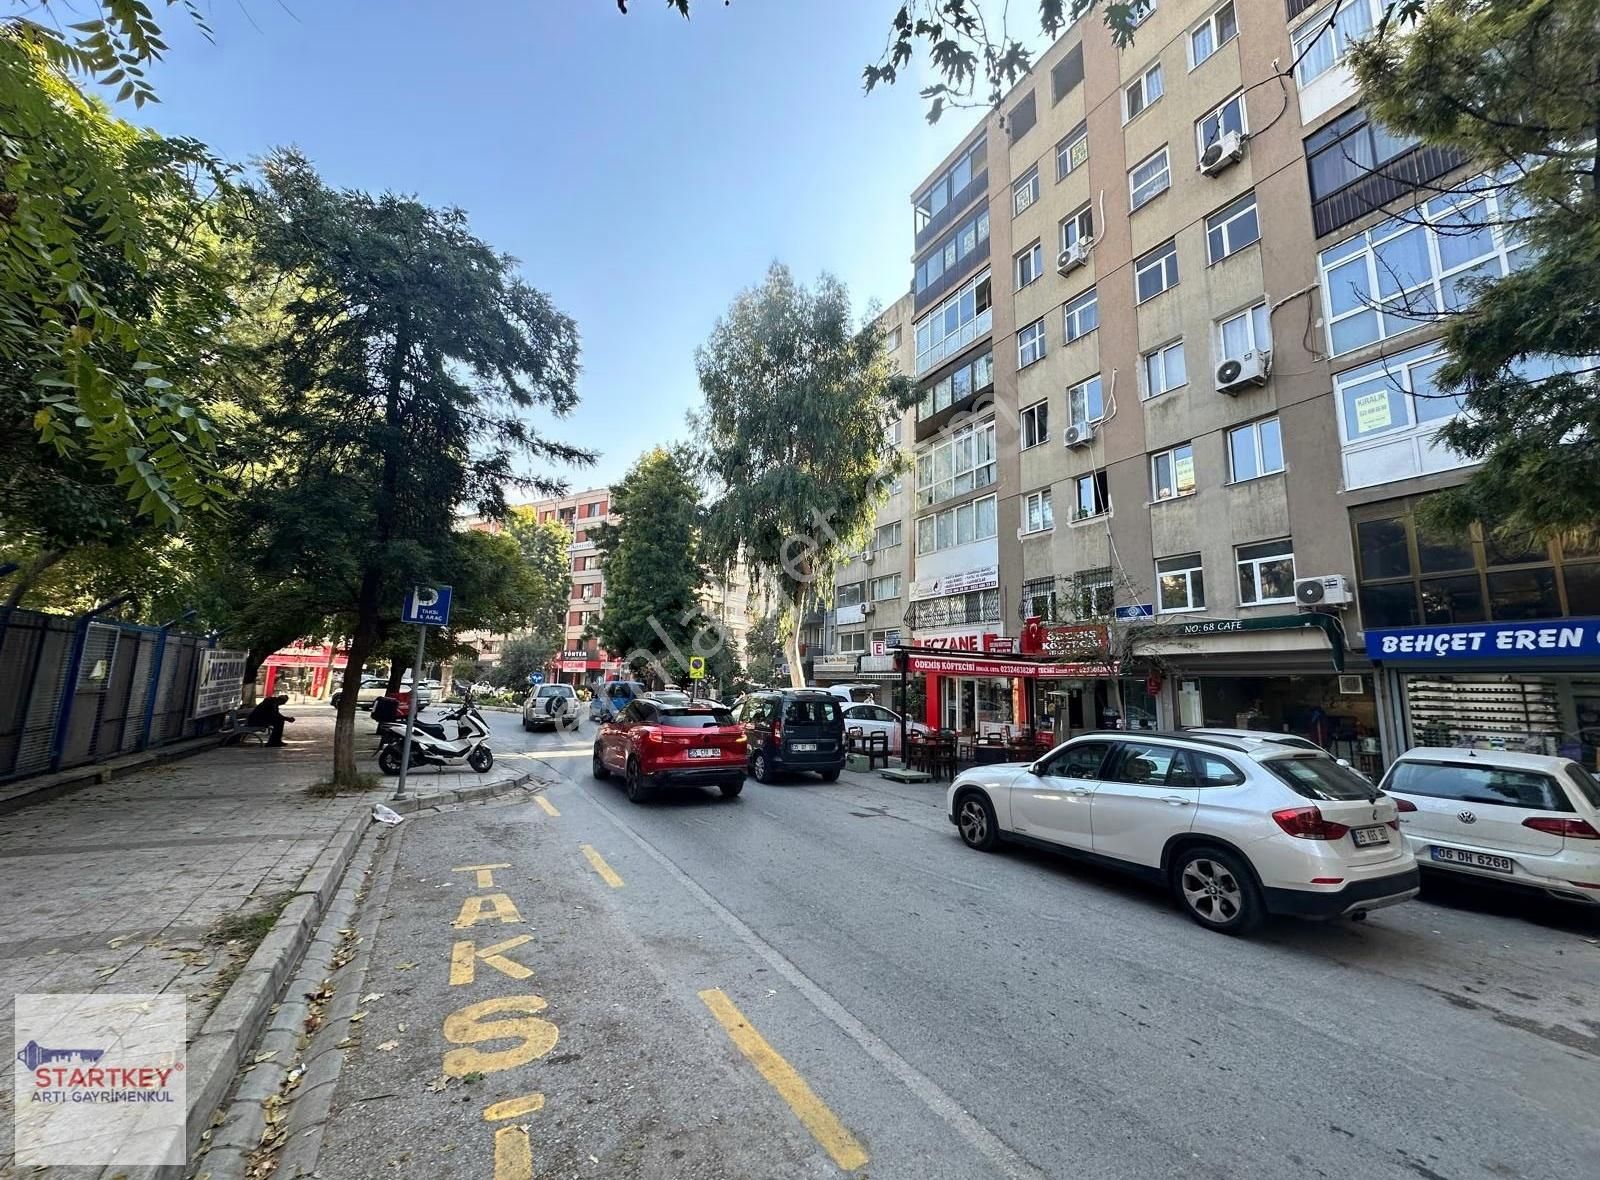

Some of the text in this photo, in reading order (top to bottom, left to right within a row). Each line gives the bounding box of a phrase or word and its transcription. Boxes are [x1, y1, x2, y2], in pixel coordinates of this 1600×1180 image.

[1203, 623, 1215, 632] 68
[1217, 621, 1242, 631] CAFE
[876, 643, 882, 654] E
[923, 635, 978, 650] ECZANE
[1382, 632, 1486, 656] BEHÇET
[1496, 627, 1584, 650] EREN
[1439, 849, 1509, 869] 06 DH 6268
